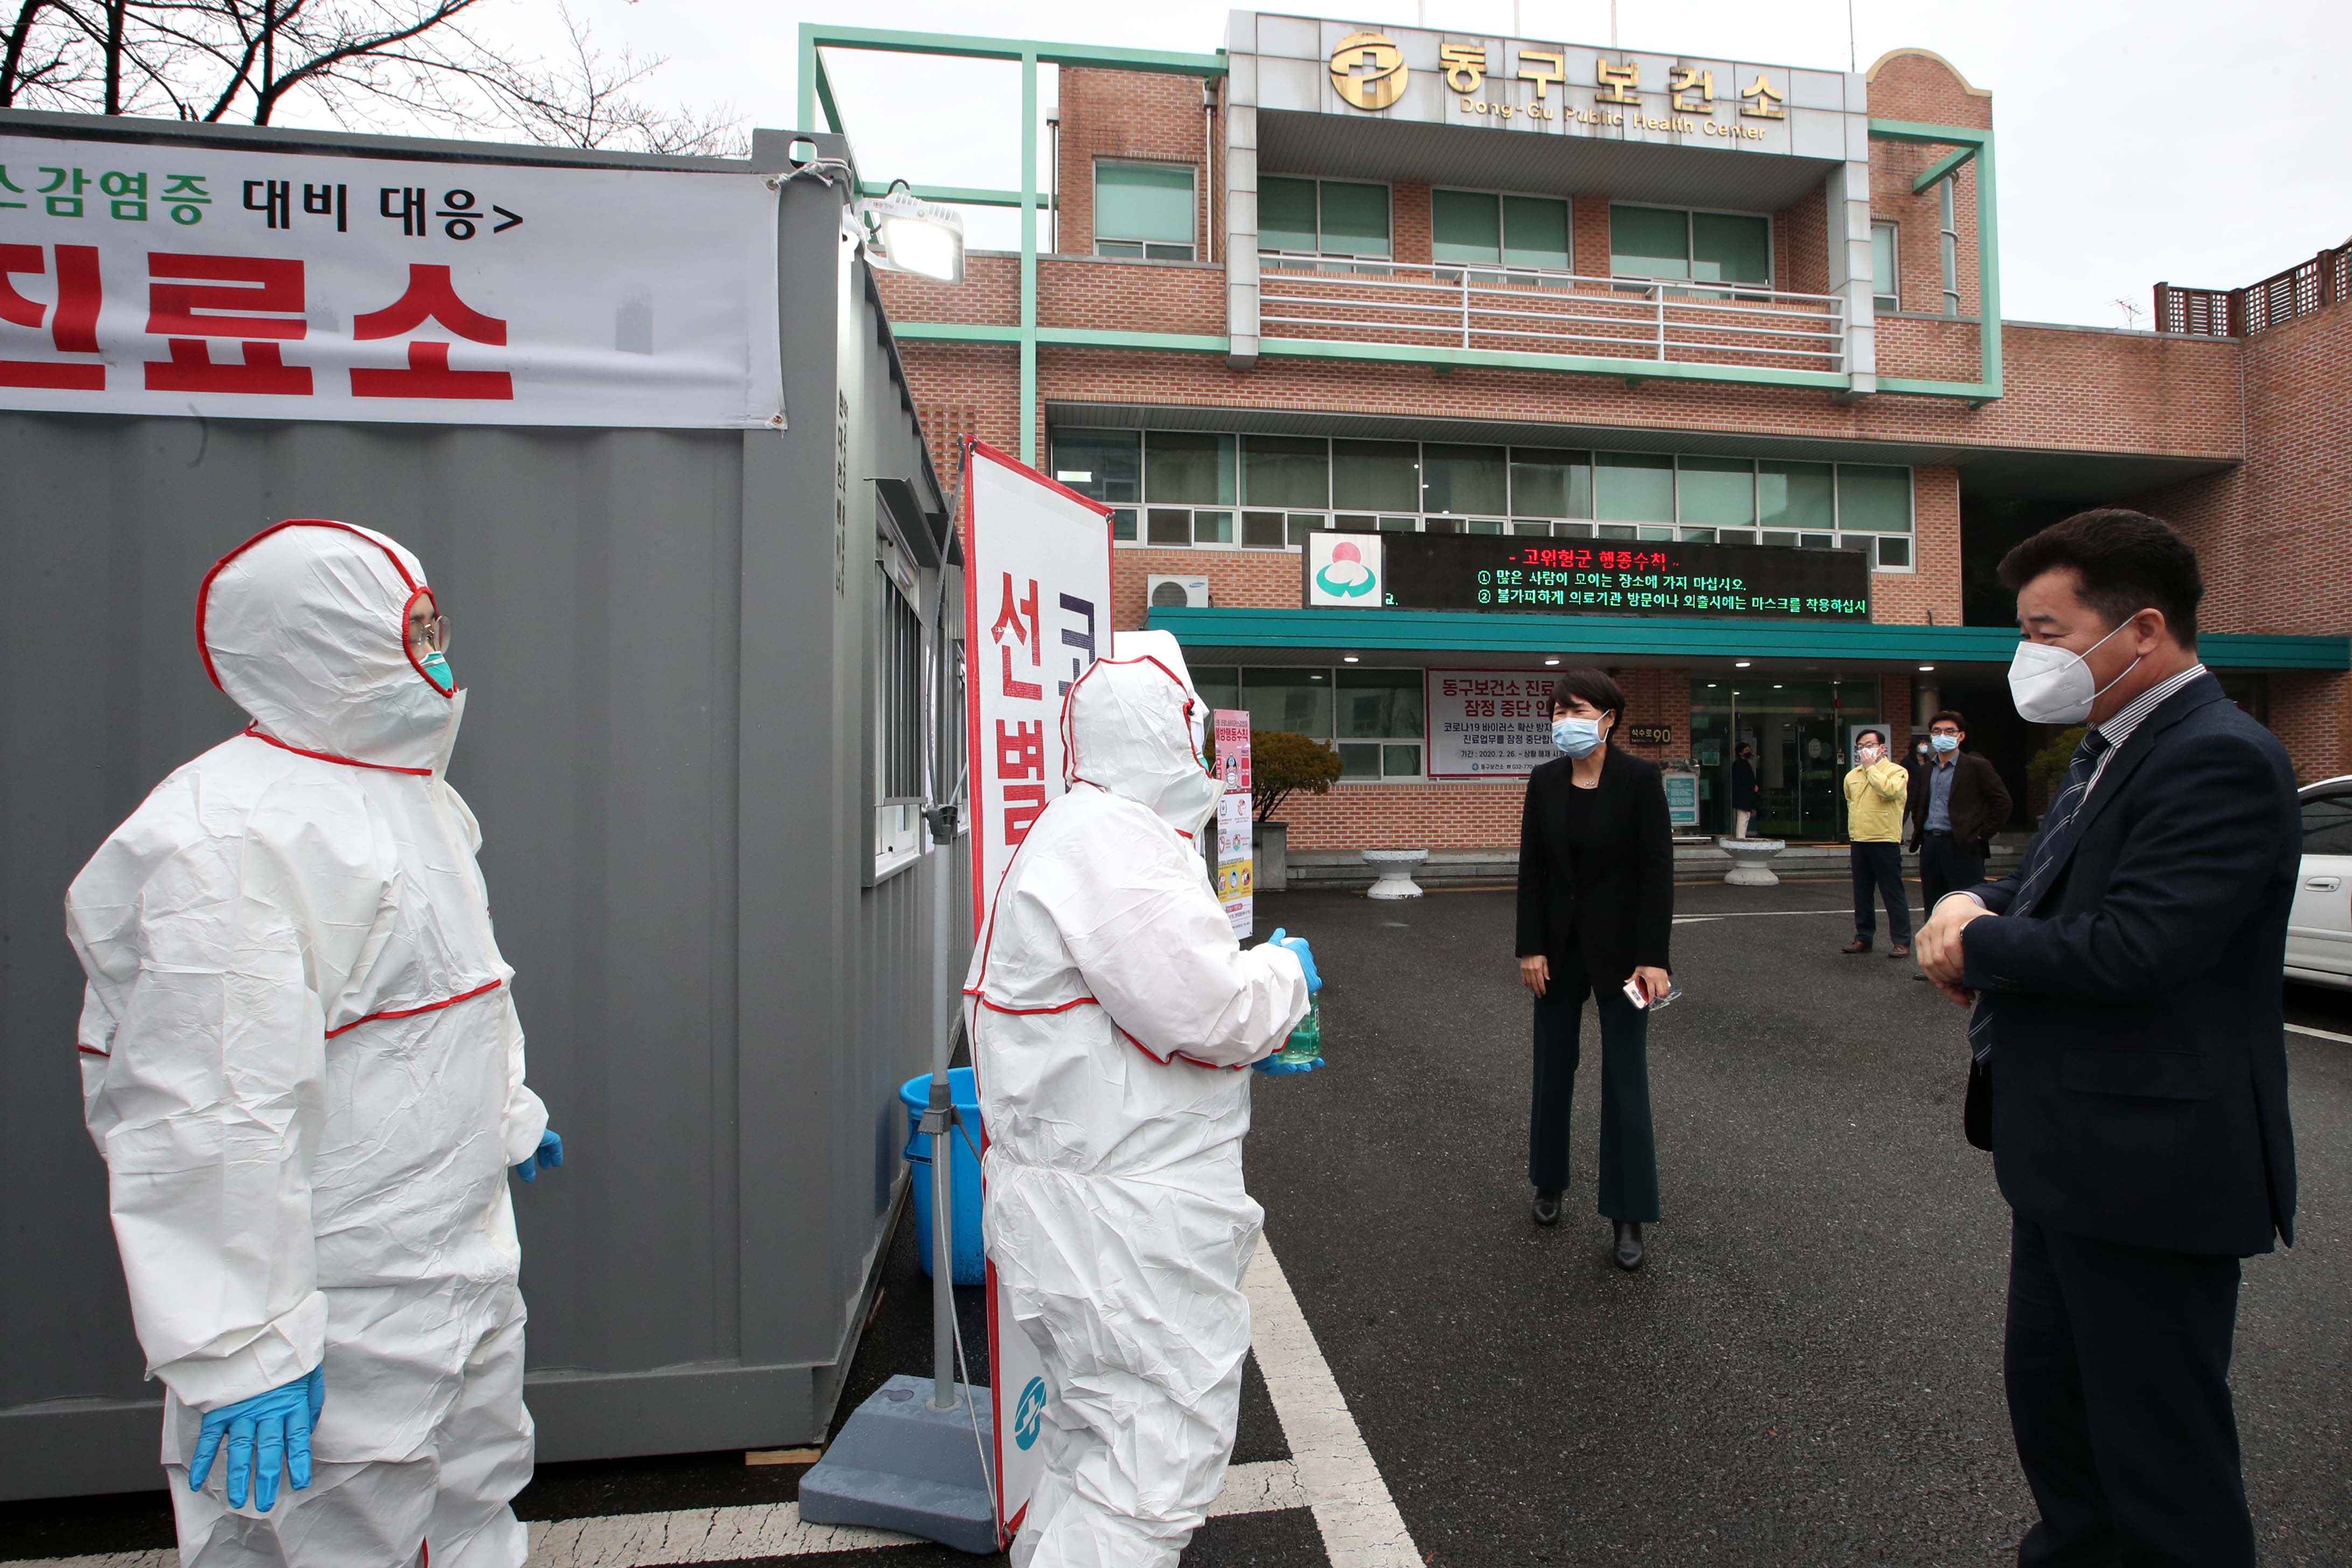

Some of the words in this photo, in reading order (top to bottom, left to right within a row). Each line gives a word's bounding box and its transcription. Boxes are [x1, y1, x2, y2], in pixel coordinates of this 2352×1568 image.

[1438, 43, 1786, 119] 동구보건소
[1564, 106, 1623, 127] Public
[1633, 111, 1695, 134] Health
[1702, 119, 1767, 141] Center
[243, 179, 348, 233] 대비
[0, 243, 514, 401] 진료소
[1496, 570, 1523, 585] 많은
[1529, 571, 1567, 586] 사람이
[1574, 573, 1612, 588] 모이는
[1619, 573, 1657, 589] 장소에
[1663, 576, 1687, 590] 가지
[1497, 589, 1564, 605] 불가피하게
[1569, 591, 1622, 606] 의료기관
[1627, 592, 1678, 608] 방문이나
[1683, 594, 1747, 610] 외출시에는
[1752, 596, 1801, 613] 마스크를
[1806, 598, 1866, 614] 착용하십시
[1443, 679, 1520, 697] 동구보건소
[1465, 700, 1495, 717] 잠정
[1501, 700, 1531, 717] 중단
[1444, 722, 1480, 732] 코로나19
[1482, 722, 1515, 732] 바이러스
[1517, 723, 1534, 732] 확산
[1632, 729, 1652, 737] 석수로
[1653, 729, 1670, 742] 90
[1464, 734, 1504, 744] 진료업무를
[1507, 734, 1523, 744] 잠정
[1461, 750, 1473, 758] 기간
